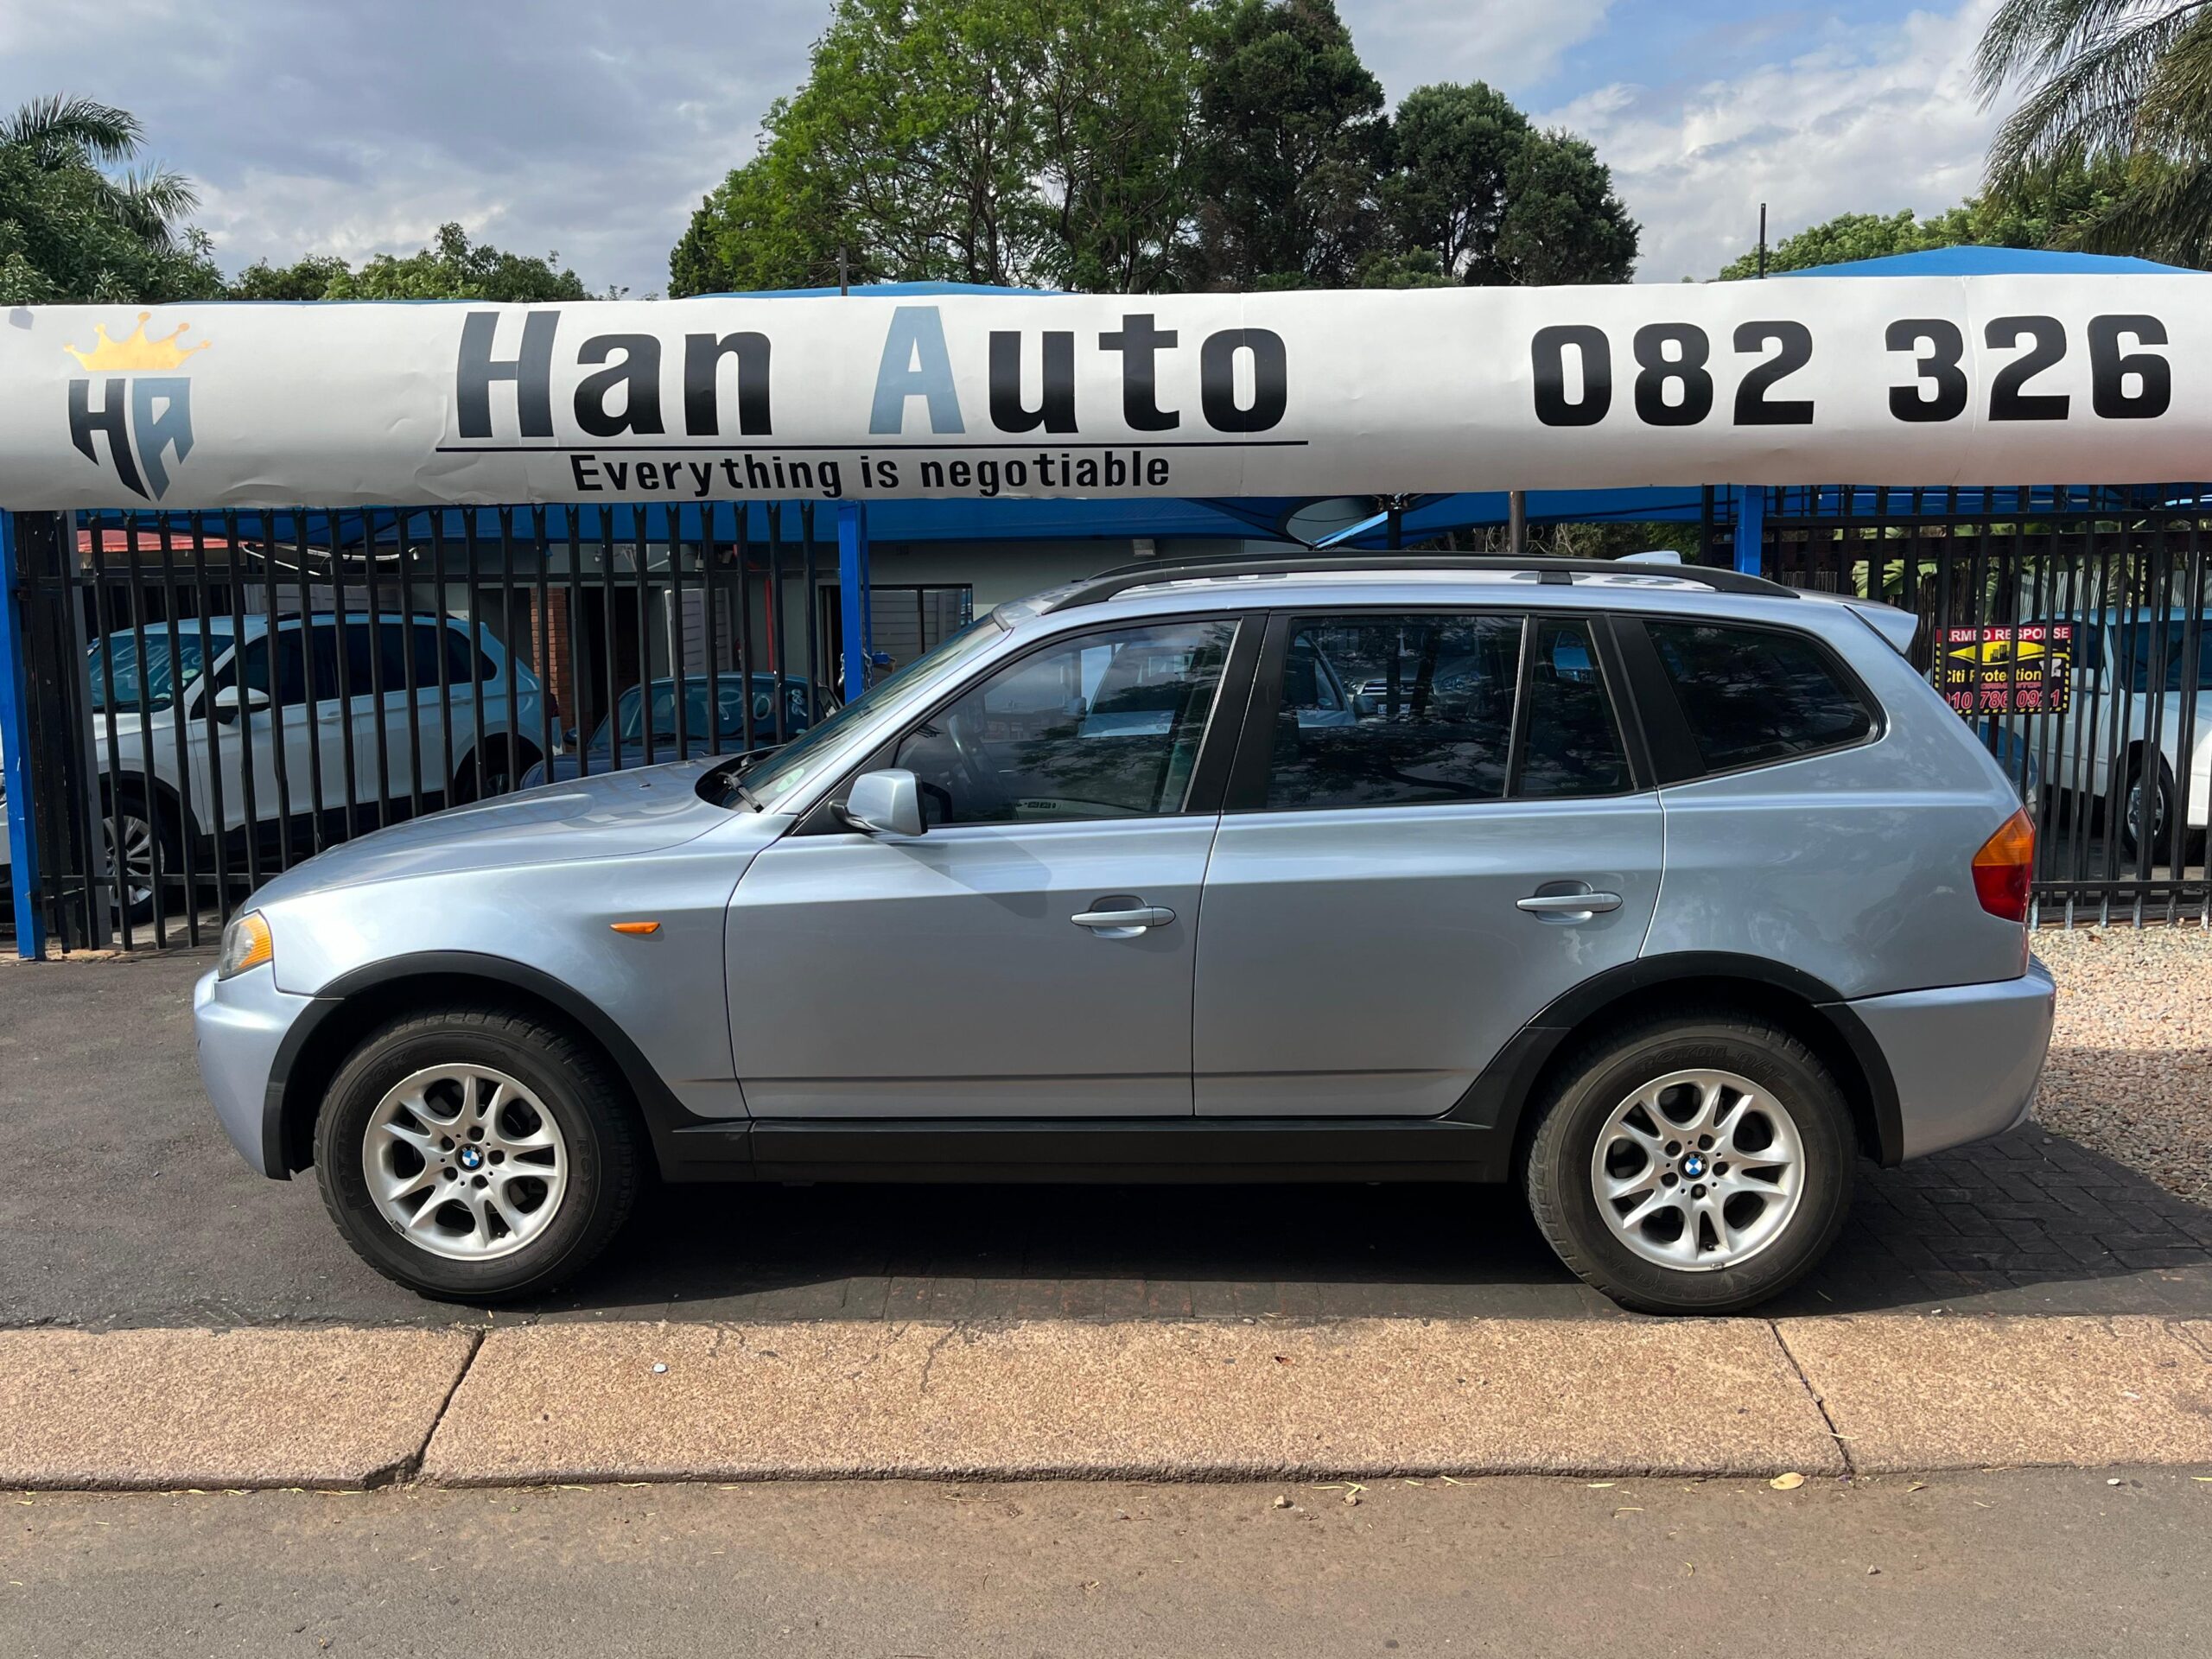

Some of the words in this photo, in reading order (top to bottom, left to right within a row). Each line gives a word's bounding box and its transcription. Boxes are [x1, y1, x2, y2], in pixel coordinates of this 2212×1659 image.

[456, 310, 772, 438] Han
[868, 305, 1288, 435] Auto
[1530, 320, 1815, 427] 082
[1885, 314, 2172, 423] 326
[570, 453, 842, 499] Everything
[861, 454, 899, 489] is
[921, 449, 1170, 498] negotiable
[1969, 667, 2043, 683] Protetion
